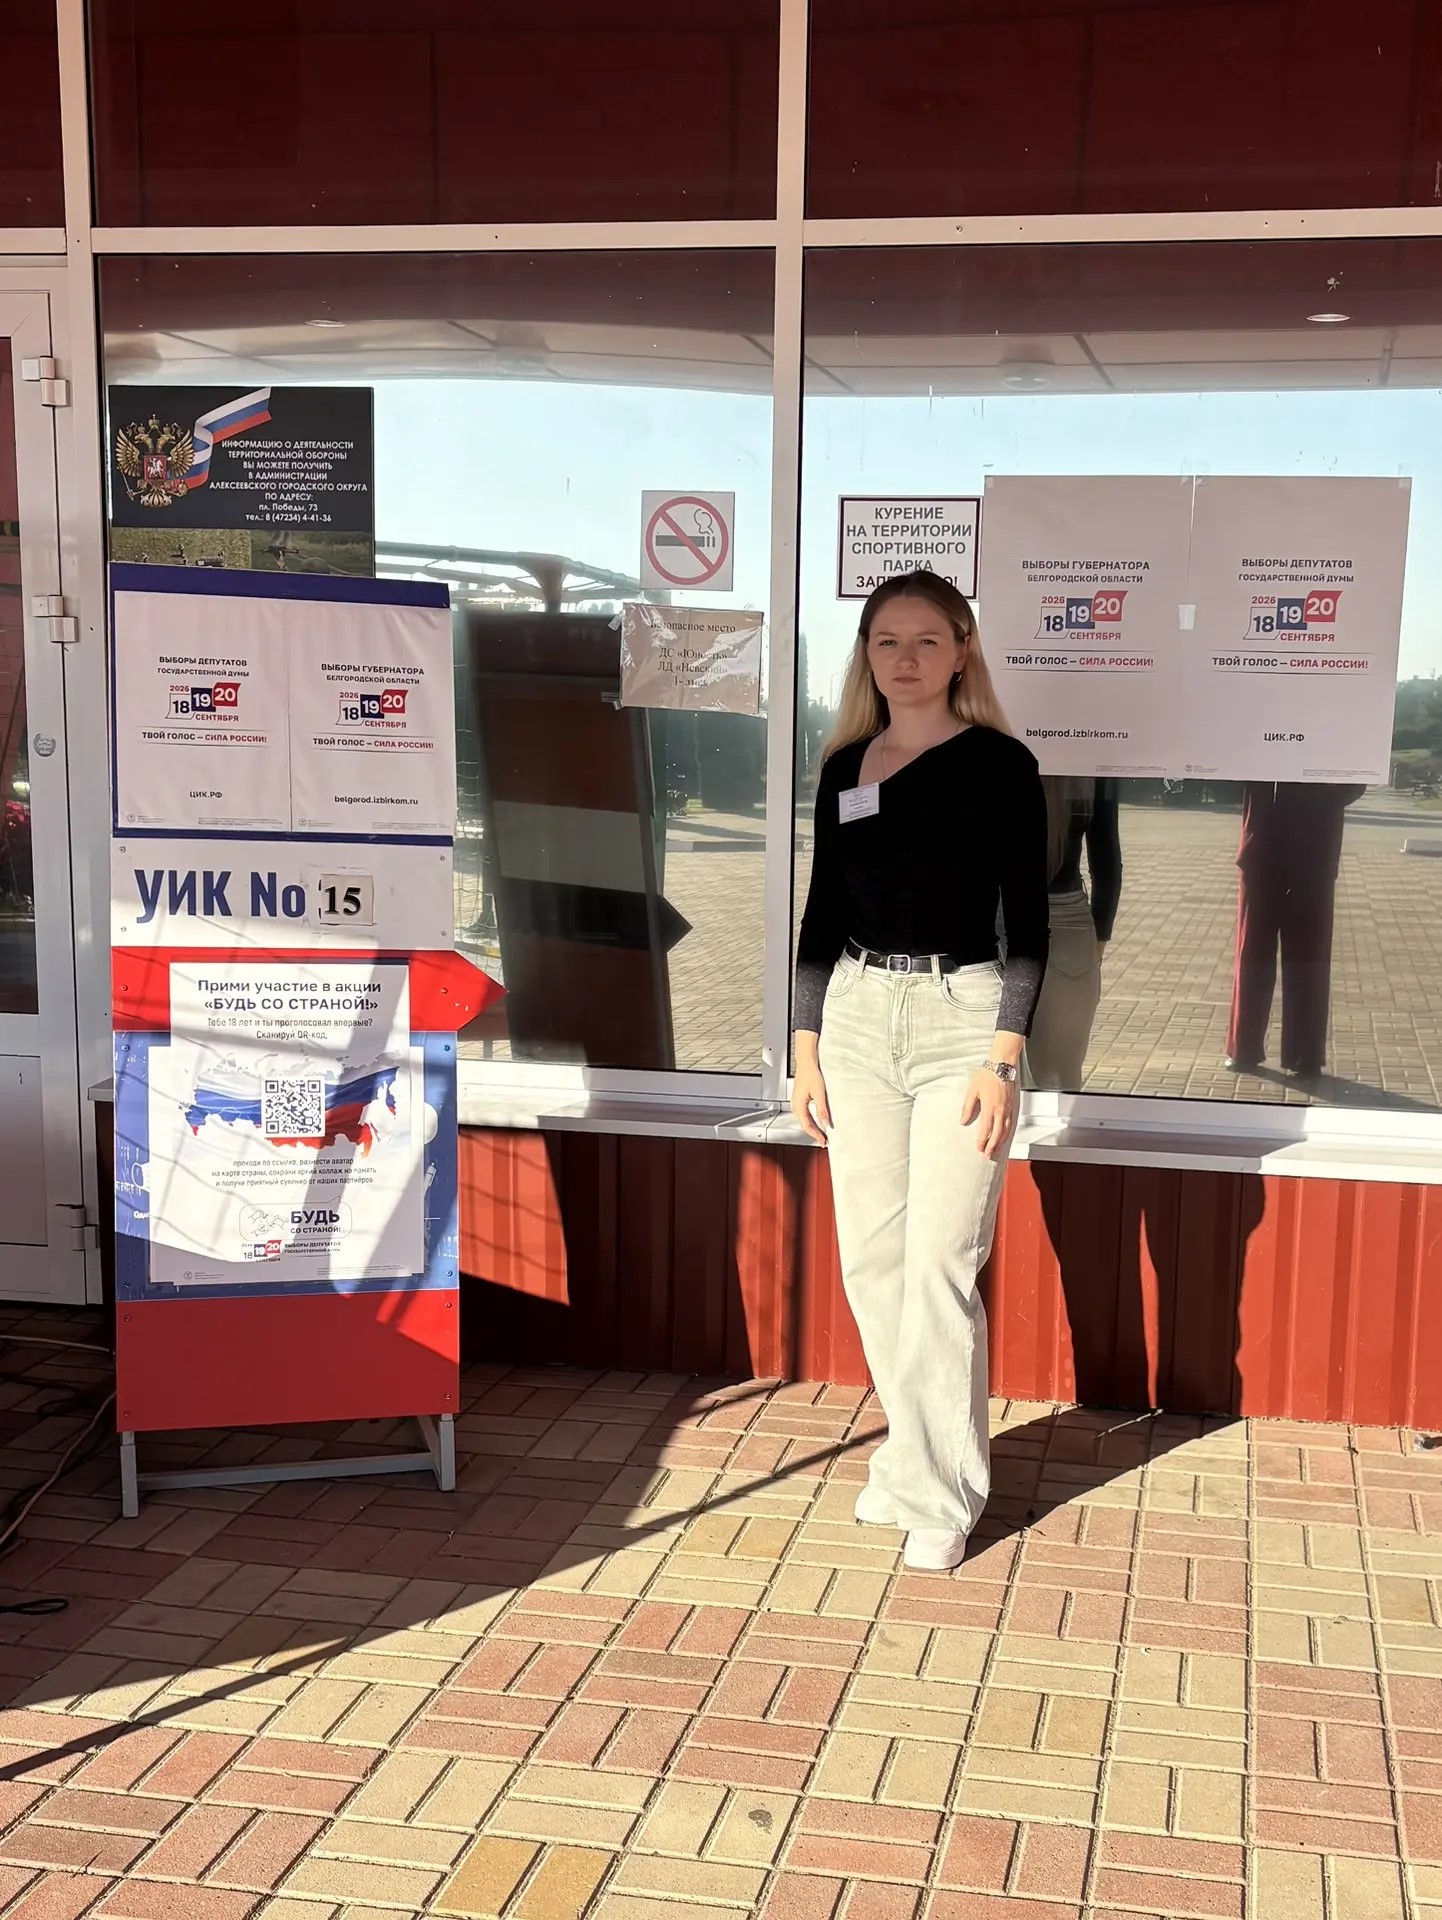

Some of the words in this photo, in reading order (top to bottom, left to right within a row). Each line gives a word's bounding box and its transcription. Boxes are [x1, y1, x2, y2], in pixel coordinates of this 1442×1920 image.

[222, 441, 282, 449] ИНФОРМАЦИЮ
[293, 441, 353, 449] ДЕЯТЕЛЬНОСТИ
[228, 450, 303, 459] ТЕРРИТОРИАЛЬНОЙ
[243, 461, 254, 469] ВЫ
[292, 462, 332, 470] ПОЛУЧИТЬ
[255, 472, 327, 480] АДМИНИСТРАЦИИ
[279, 482, 334, 490] ГОРОДСКОГО
[337, 483, 367, 491] ОКРУГА
[272, 514, 300, 522] (47234)
[303, 514, 331, 522] 4-41-36
[875, 507, 943, 519] КУРЕНИЕ
[847, 525, 866, 537] НА
[872, 524, 971, 537] ТЕРРИТОРИИ
[852, 542, 965, 554] СПОРТИВНОГО
[884, 560, 933, 571] ПАРКА
[1022, 560, 1069, 570] ВЫБОРЫ
[1072, 561, 1149, 570] ГУБЕРНАТОРА
[1242, 559, 1288, 567] ВЫБОРЫ
[1290, 559, 1352, 569] ДЕПУТАТОВ
[856, 576, 958, 588] ЗАПО!
[1028, 574, 1099, 583] БЕЛГОРОДСКОЙ
[1100, 575, 1143, 583] ОБЛАСТИ
[1239, 574, 1325, 582] ГОСУДАРСТВЕННОЙ
[1327, 575, 1354, 583] ДУМЫ
[1042, 596, 1065, 604] 2026
[1251, 596, 1276, 604] 2026
[1043, 616, 1064, 632] 18
[1069, 606, 1090, 622] 19
[1094, 598, 1120, 615] 20
[1253, 616, 1274, 632] 18
[1279, 606, 1302, 623] 19
[1307, 598, 1334, 615] 20
[708, 624, 735, 632] место
[1069, 632, 1121, 640] СЕНТЯБРЯ
[1280, 633, 1334, 642] СЕНТЯБРЯ
[659, 648, 674, 658] ДС
[159, 656, 196, 664] ВЫБОРЫ
[198, 658, 247, 666] ДЕПУТАТОВ
[1006, 655, 1032, 664] ТВОЙ
[1035, 656, 1067, 665] ГОЛОС
[1079, 657, 1106, 665] СИЛА
[1109, 658, 1153, 666] РОССИИ!
[1212, 657, 1240, 666] ТВОЙ
[1242, 658, 1277, 667] ГОЛОС
[1290, 659, 1318, 668] СИЛА
[1321, 660, 1368, 668] РОССИИ!
[158, 668, 227, 676] ГОСУДАРСТВЕННОЙ
[321, 663, 360, 672] ВЫБОРЫ
[362, 666, 424, 675] ГУБЕРНАТОРА
[327, 675, 385, 683] БЕЛГОРОДСКОЙ
[386, 677, 420, 685] ОБЛАСТИ
[172, 700, 190, 713] 18
[193, 694, 210, 707] 19
[214, 688, 235, 701] 20
[342, 707, 359, 720] 18
[362, 700, 380, 714] 19
[383, 695, 403, 708] 20
[365, 720, 406, 728] СЕНТЯБРЯ
[142, 731, 165, 739] ТВОЙ
[1026, 728, 1128, 739] belgorod.izbirkom.ru
[1264, 733, 1304, 742] ЦИК.РФ
[313, 737, 335, 745] ТВОЙ
[334, 796, 418, 805] belgorod.izbirkom.ru
[134, 868, 233, 924] УИК
[324, 886, 361, 915] 15
[198, 980, 250, 993] Прими
[255, 982, 317, 994] участие
[322, 983, 330, 991] в
[335, 982, 381, 993] акции
[204, 998, 256, 1011] «БУДЬ
[261, 999, 284, 1009] СО
[288, 996, 378, 1010] СТРАНОЙ!»
[228, 1018, 236, 1026] 18
[333, 1018, 373, 1028] впервые?
[256, 1030, 295, 1040] Сканируй
[291, 1210, 340, 1225] БУДЬ
